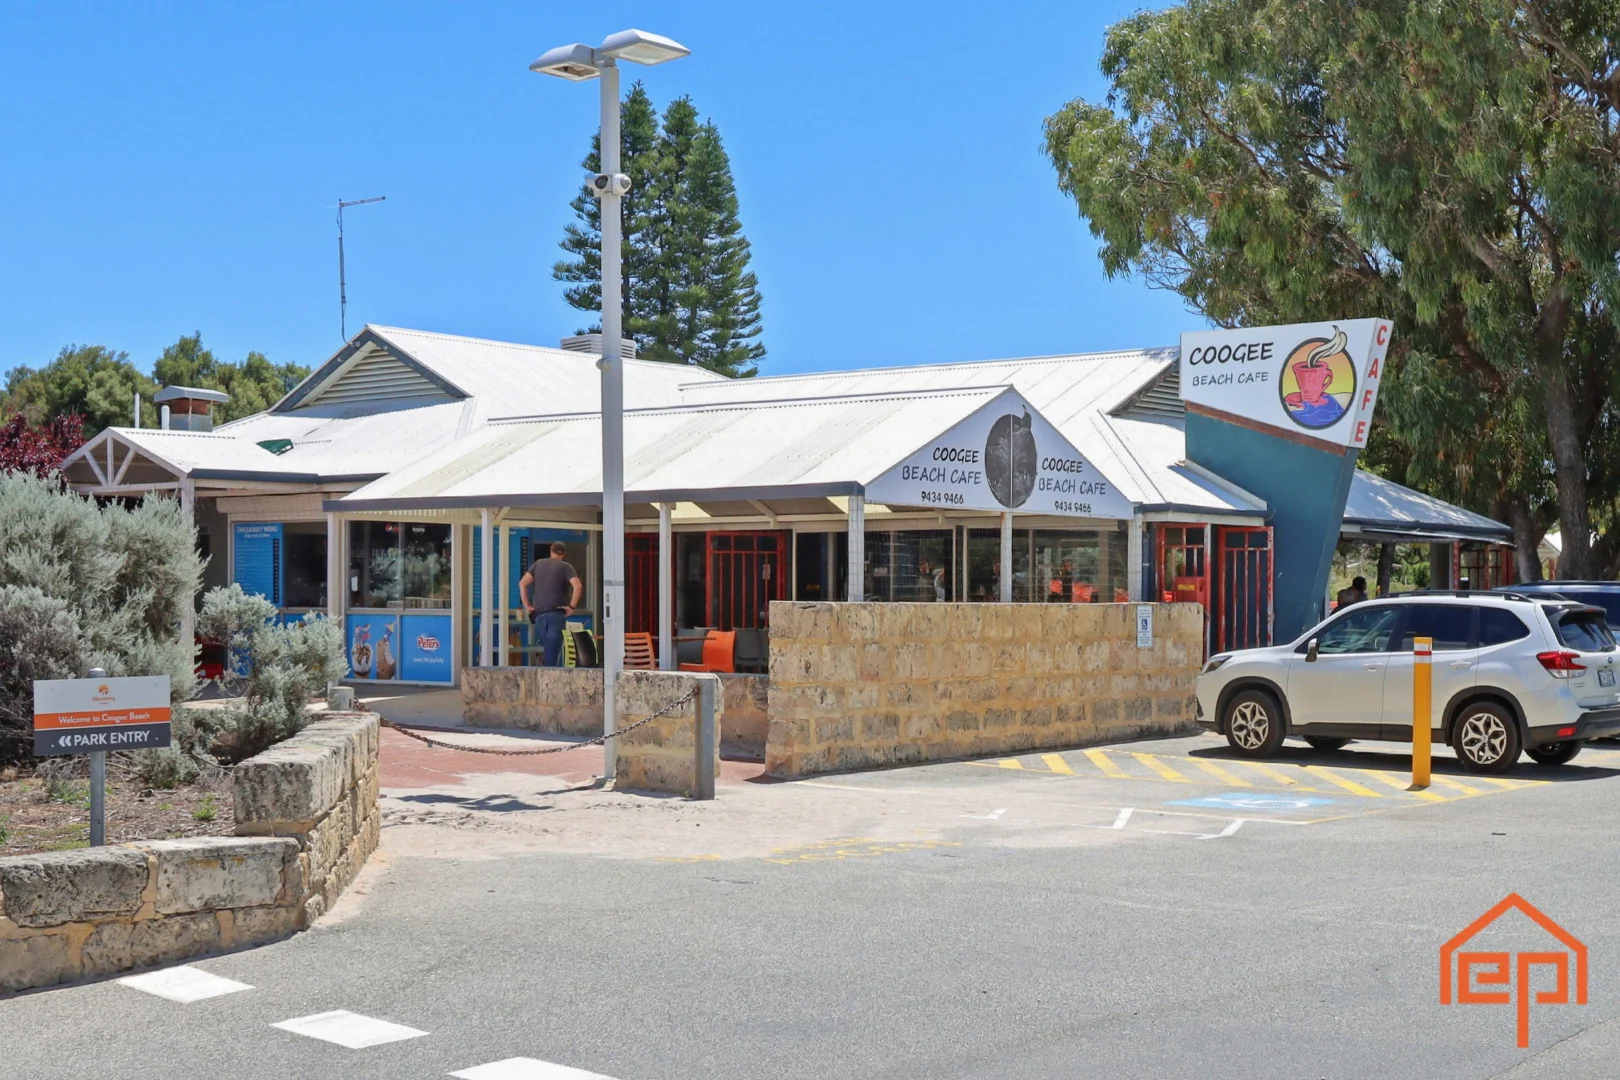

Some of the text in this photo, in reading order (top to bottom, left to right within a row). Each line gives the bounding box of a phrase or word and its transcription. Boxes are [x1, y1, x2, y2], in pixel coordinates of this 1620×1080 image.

[1189, 342, 1274, 366] COOGEE
[1192, 371, 1269, 387] BEACH CAFE
[1354, 325, 1388, 443] CAFE
[932, 447, 979, 464] COOGEE
[1042, 457, 1083, 474] COOGEE
[902, 465, 982, 485] BEACH CAFE
[1038, 478, 1107, 495] BEACH CAFE
[921, 491, 964, 505] 9434 9466
[1054, 500, 1092, 513] 9434 9466
[58, 711, 150, 724] Welcome to Coogee Beach
[74, 730, 150, 746] PARK ENTRY
